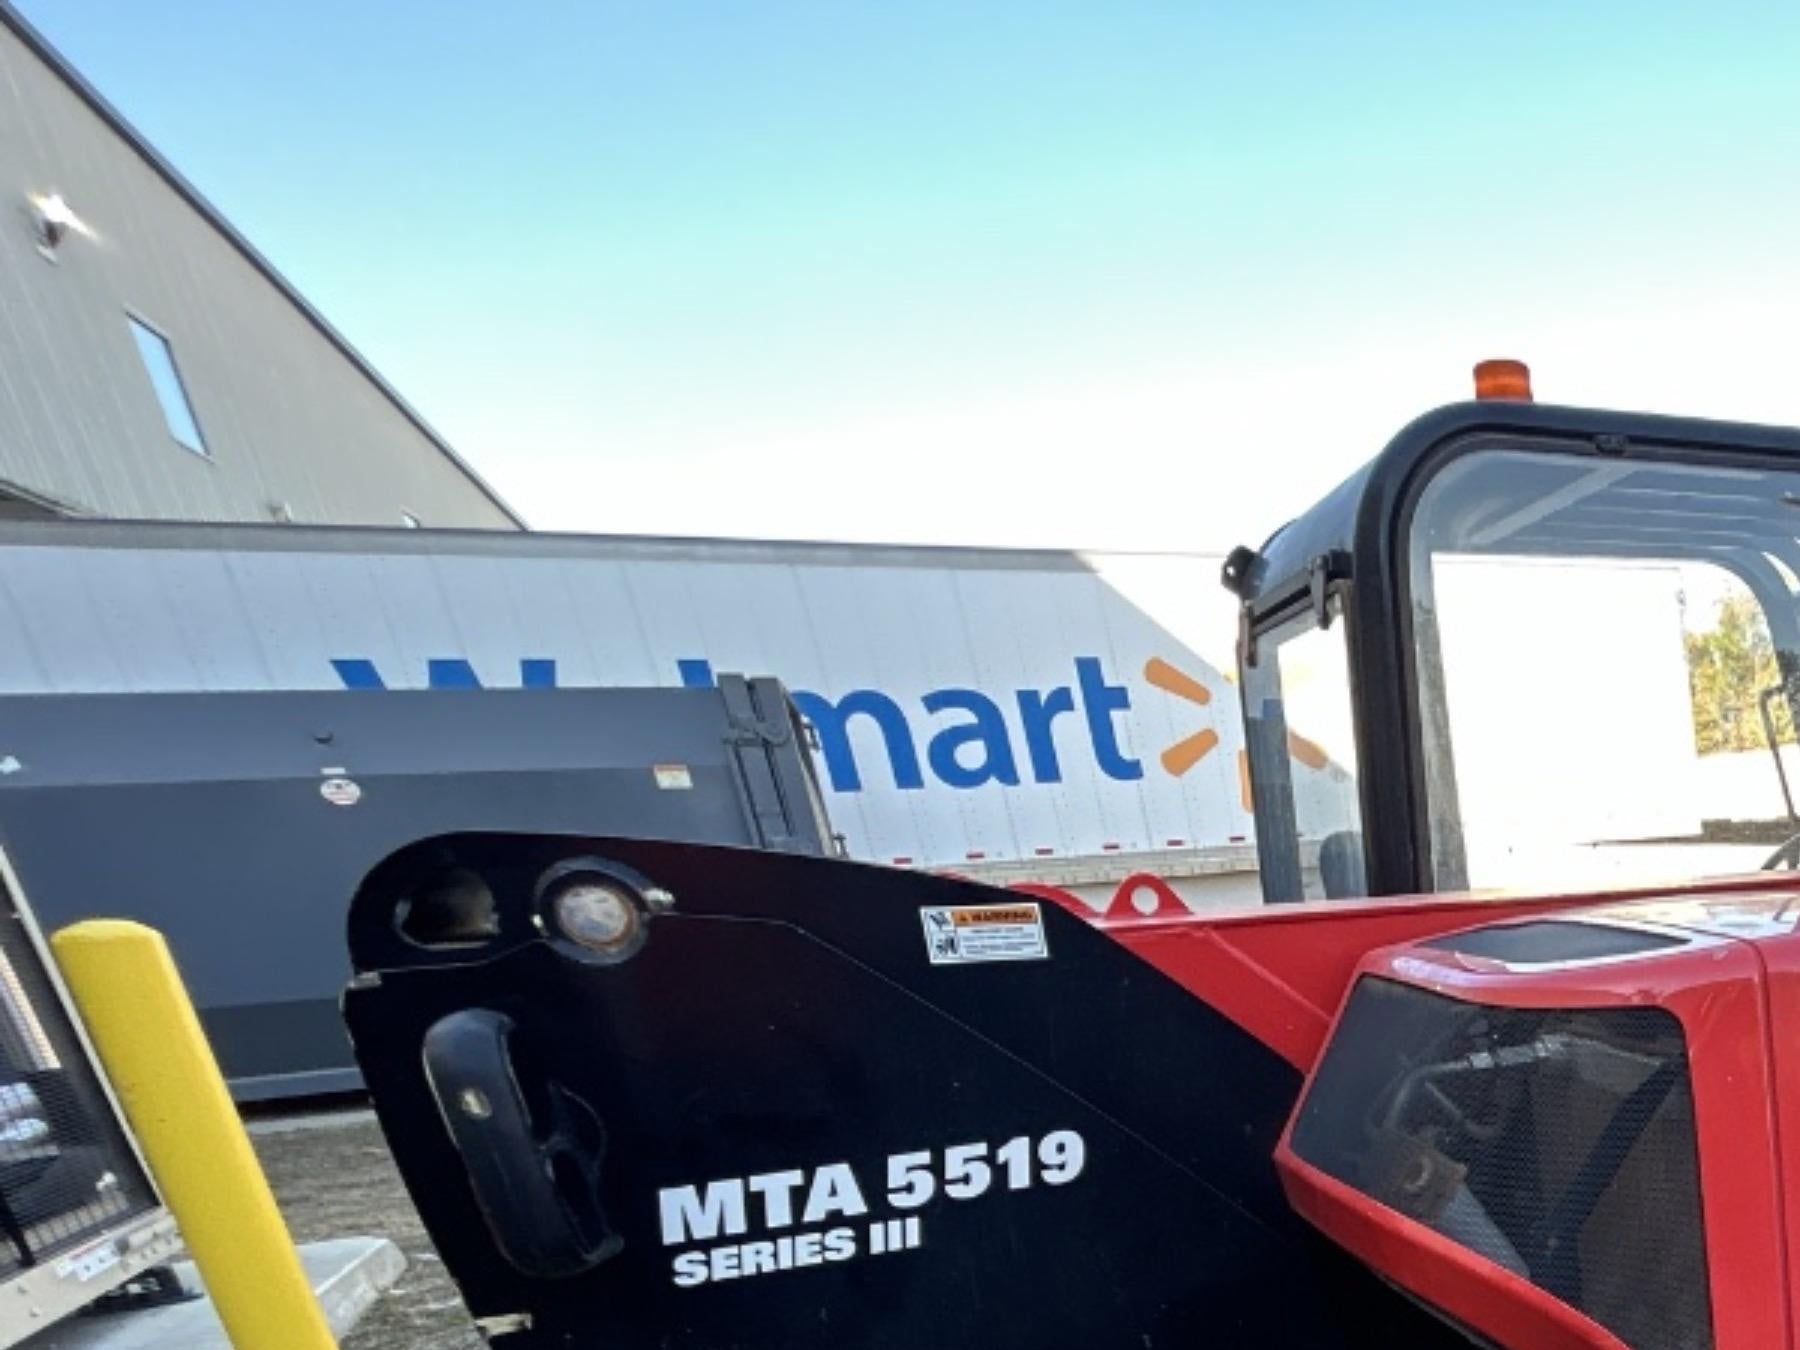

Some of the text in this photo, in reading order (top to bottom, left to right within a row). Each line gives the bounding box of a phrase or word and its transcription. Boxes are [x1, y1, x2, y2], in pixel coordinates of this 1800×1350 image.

[330, 656, 1143, 793] mart
[657, 1129, 1087, 1246] MTA 5519
[672, 1215, 922, 1288] SERIES III
